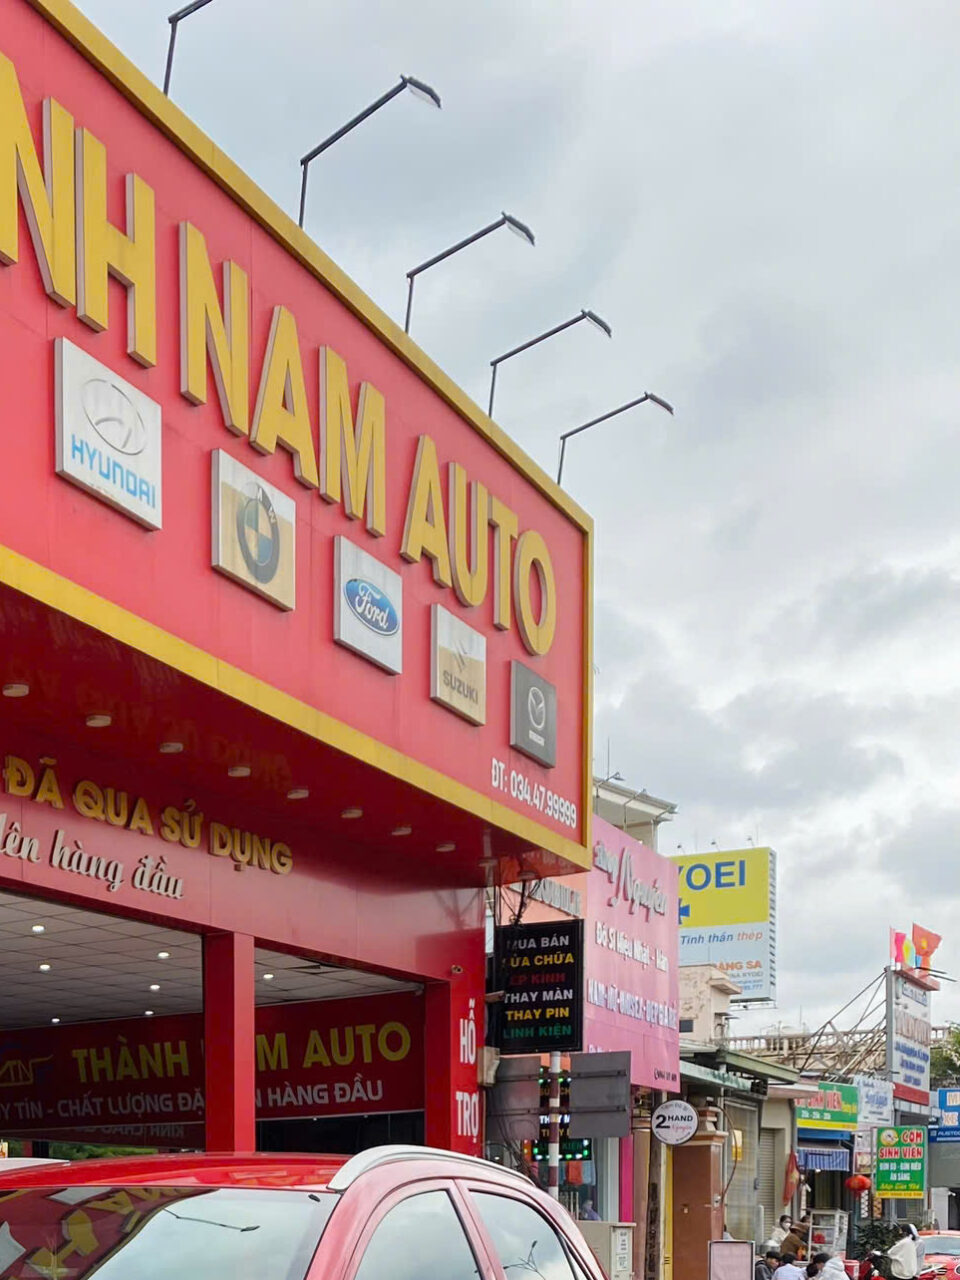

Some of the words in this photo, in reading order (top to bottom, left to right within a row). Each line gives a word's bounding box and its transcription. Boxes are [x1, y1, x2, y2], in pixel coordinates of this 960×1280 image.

[179, 220, 386, 538] NAM
[399, 434, 557, 656] AUTO
[71, 433, 157, 510] HYUNDAI
[354, 582, 390, 630] Ford
[442, 670, 479, 706] SUZUKI
[491, 757, 508, 793] ĐT:
[510, 768, 577, 830] 034.47.99999
[4, 755, 64, 809] ĐÃ
[72, 779, 154, 836] QUA
[160, 799, 204, 849] SỬ
[209, 821, 294, 876] DỤNG
[49, 828, 125, 892] hàng
[131, 853, 185, 900] đầu
[678, 860, 746, 891] OEI
[541, 933, 569, 948] BÁN
[504, 991, 539, 1004] THAY
[542, 986, 574, 1002] MÀN
[459, 998, 477, 1065] HỖ
[503, 1026, 535, 1040] LINH
[537, 1023, 572, 1040] KIỆN
[505, 1008, 542, 1021] THAY
[545, 1006, 570, 1019] PIN
[72, 1035, 190, 1084] THÀNH
[303, 1021, 412, 1069] AUTO
[13, 1100, 42, 1120] TÍN
[178, 1088, 206, 1116] ĐẶ
[268, 1078, 329, 1107] HÀNG
[333, 1072, 384, 1102] ĐẦU
[456, 1090, 480, 1144] TRỢ
[540, 1115, 562, 1124] THY
[655, 1114, 670, 1129] 2
[878, 1146, 901, 1160] SINH
